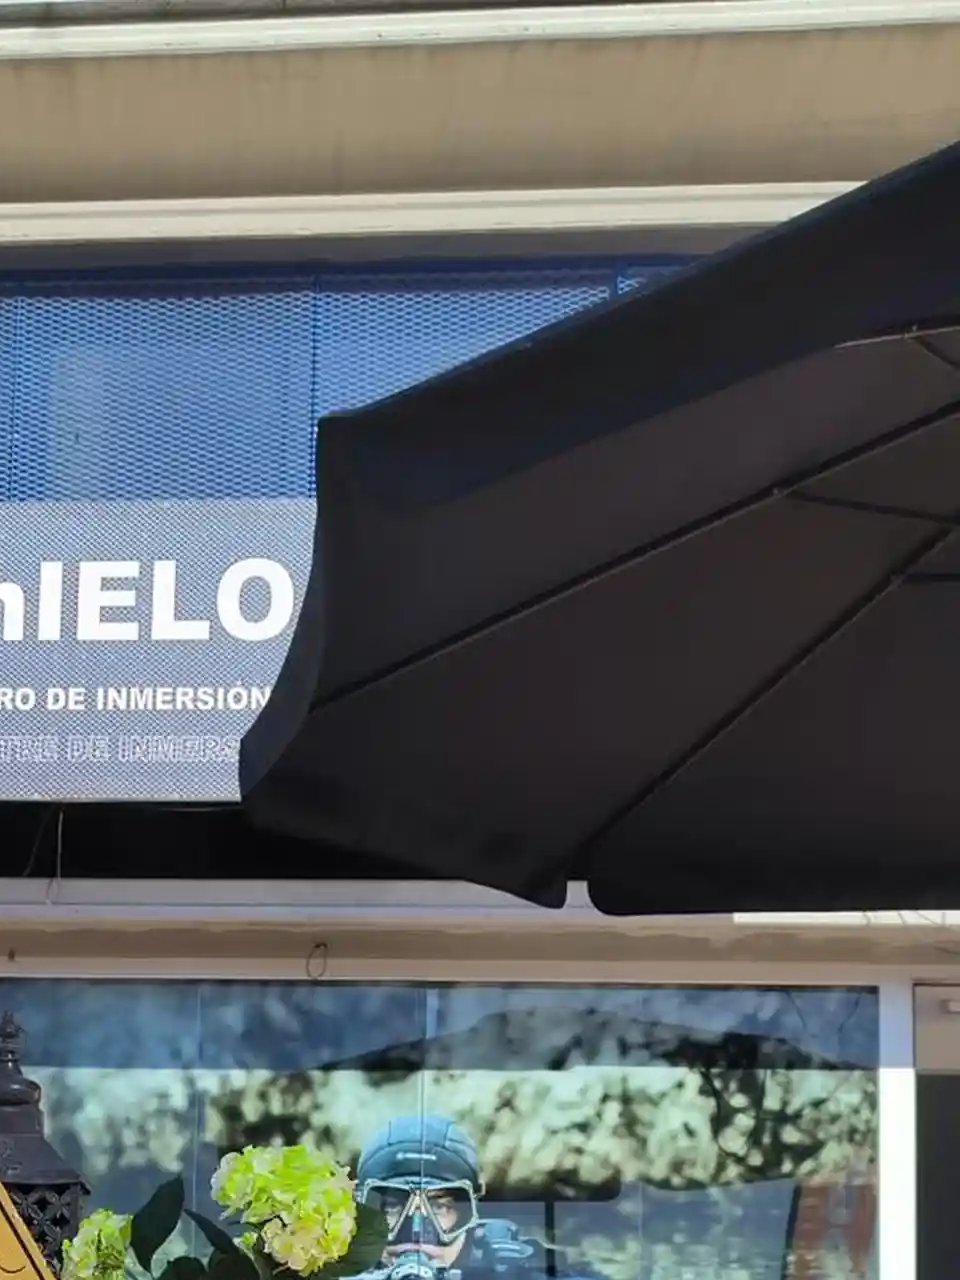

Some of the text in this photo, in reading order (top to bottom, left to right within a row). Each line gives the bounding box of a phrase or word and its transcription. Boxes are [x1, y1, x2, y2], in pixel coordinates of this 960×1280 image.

[47, 687, 86, 710] DE
[97, 679, 272, 710] INMERSIÓN
[68, 735, 109, 762] DE
